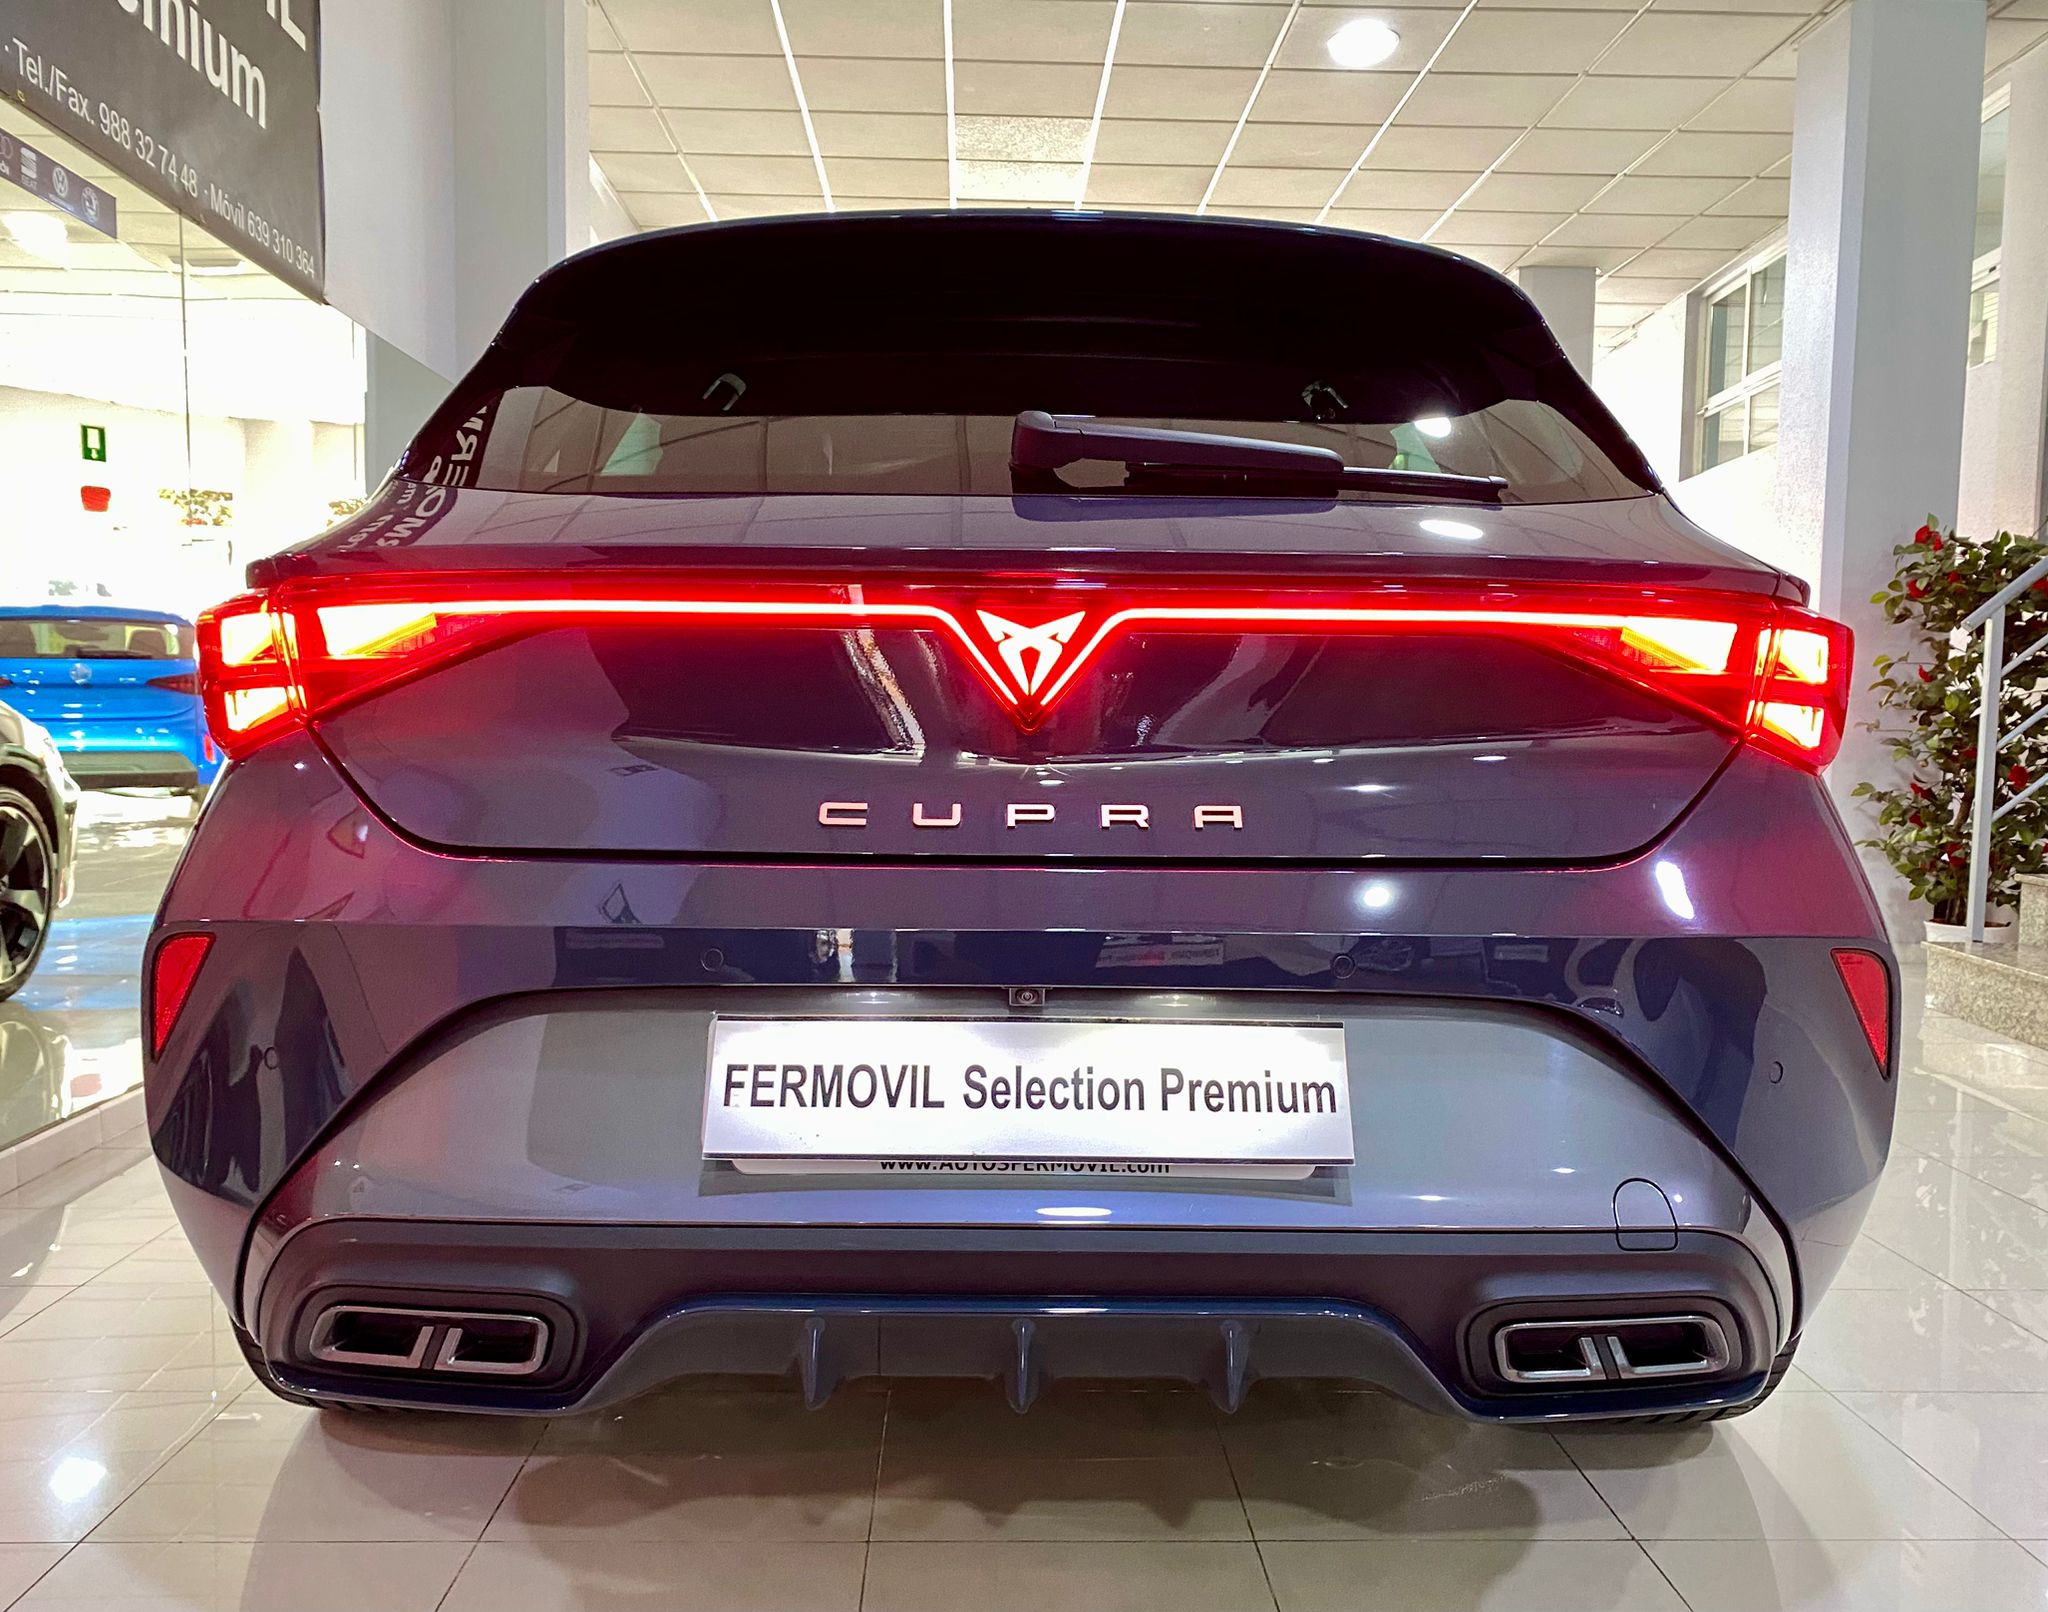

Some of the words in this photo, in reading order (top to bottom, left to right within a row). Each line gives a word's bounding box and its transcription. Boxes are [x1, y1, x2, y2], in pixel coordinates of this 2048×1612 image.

[100, 102, 132, 150] 988
[135, 128, 156, 169] 32
[158, 144, 178, 183] 74
[180, 163, 198, 198] 48
[247, 210, 270, 247] 639
[272, 229, 293, 264] 310
[295, 246, 315, 279] 364
[818, 801, 1244, 830] CUPRA
[723, 1063, 946, 1110] FERMOVIL
[962, 1063, 1146, 1111] Selection
[1160, 1066, 1338, 1114] Premium
